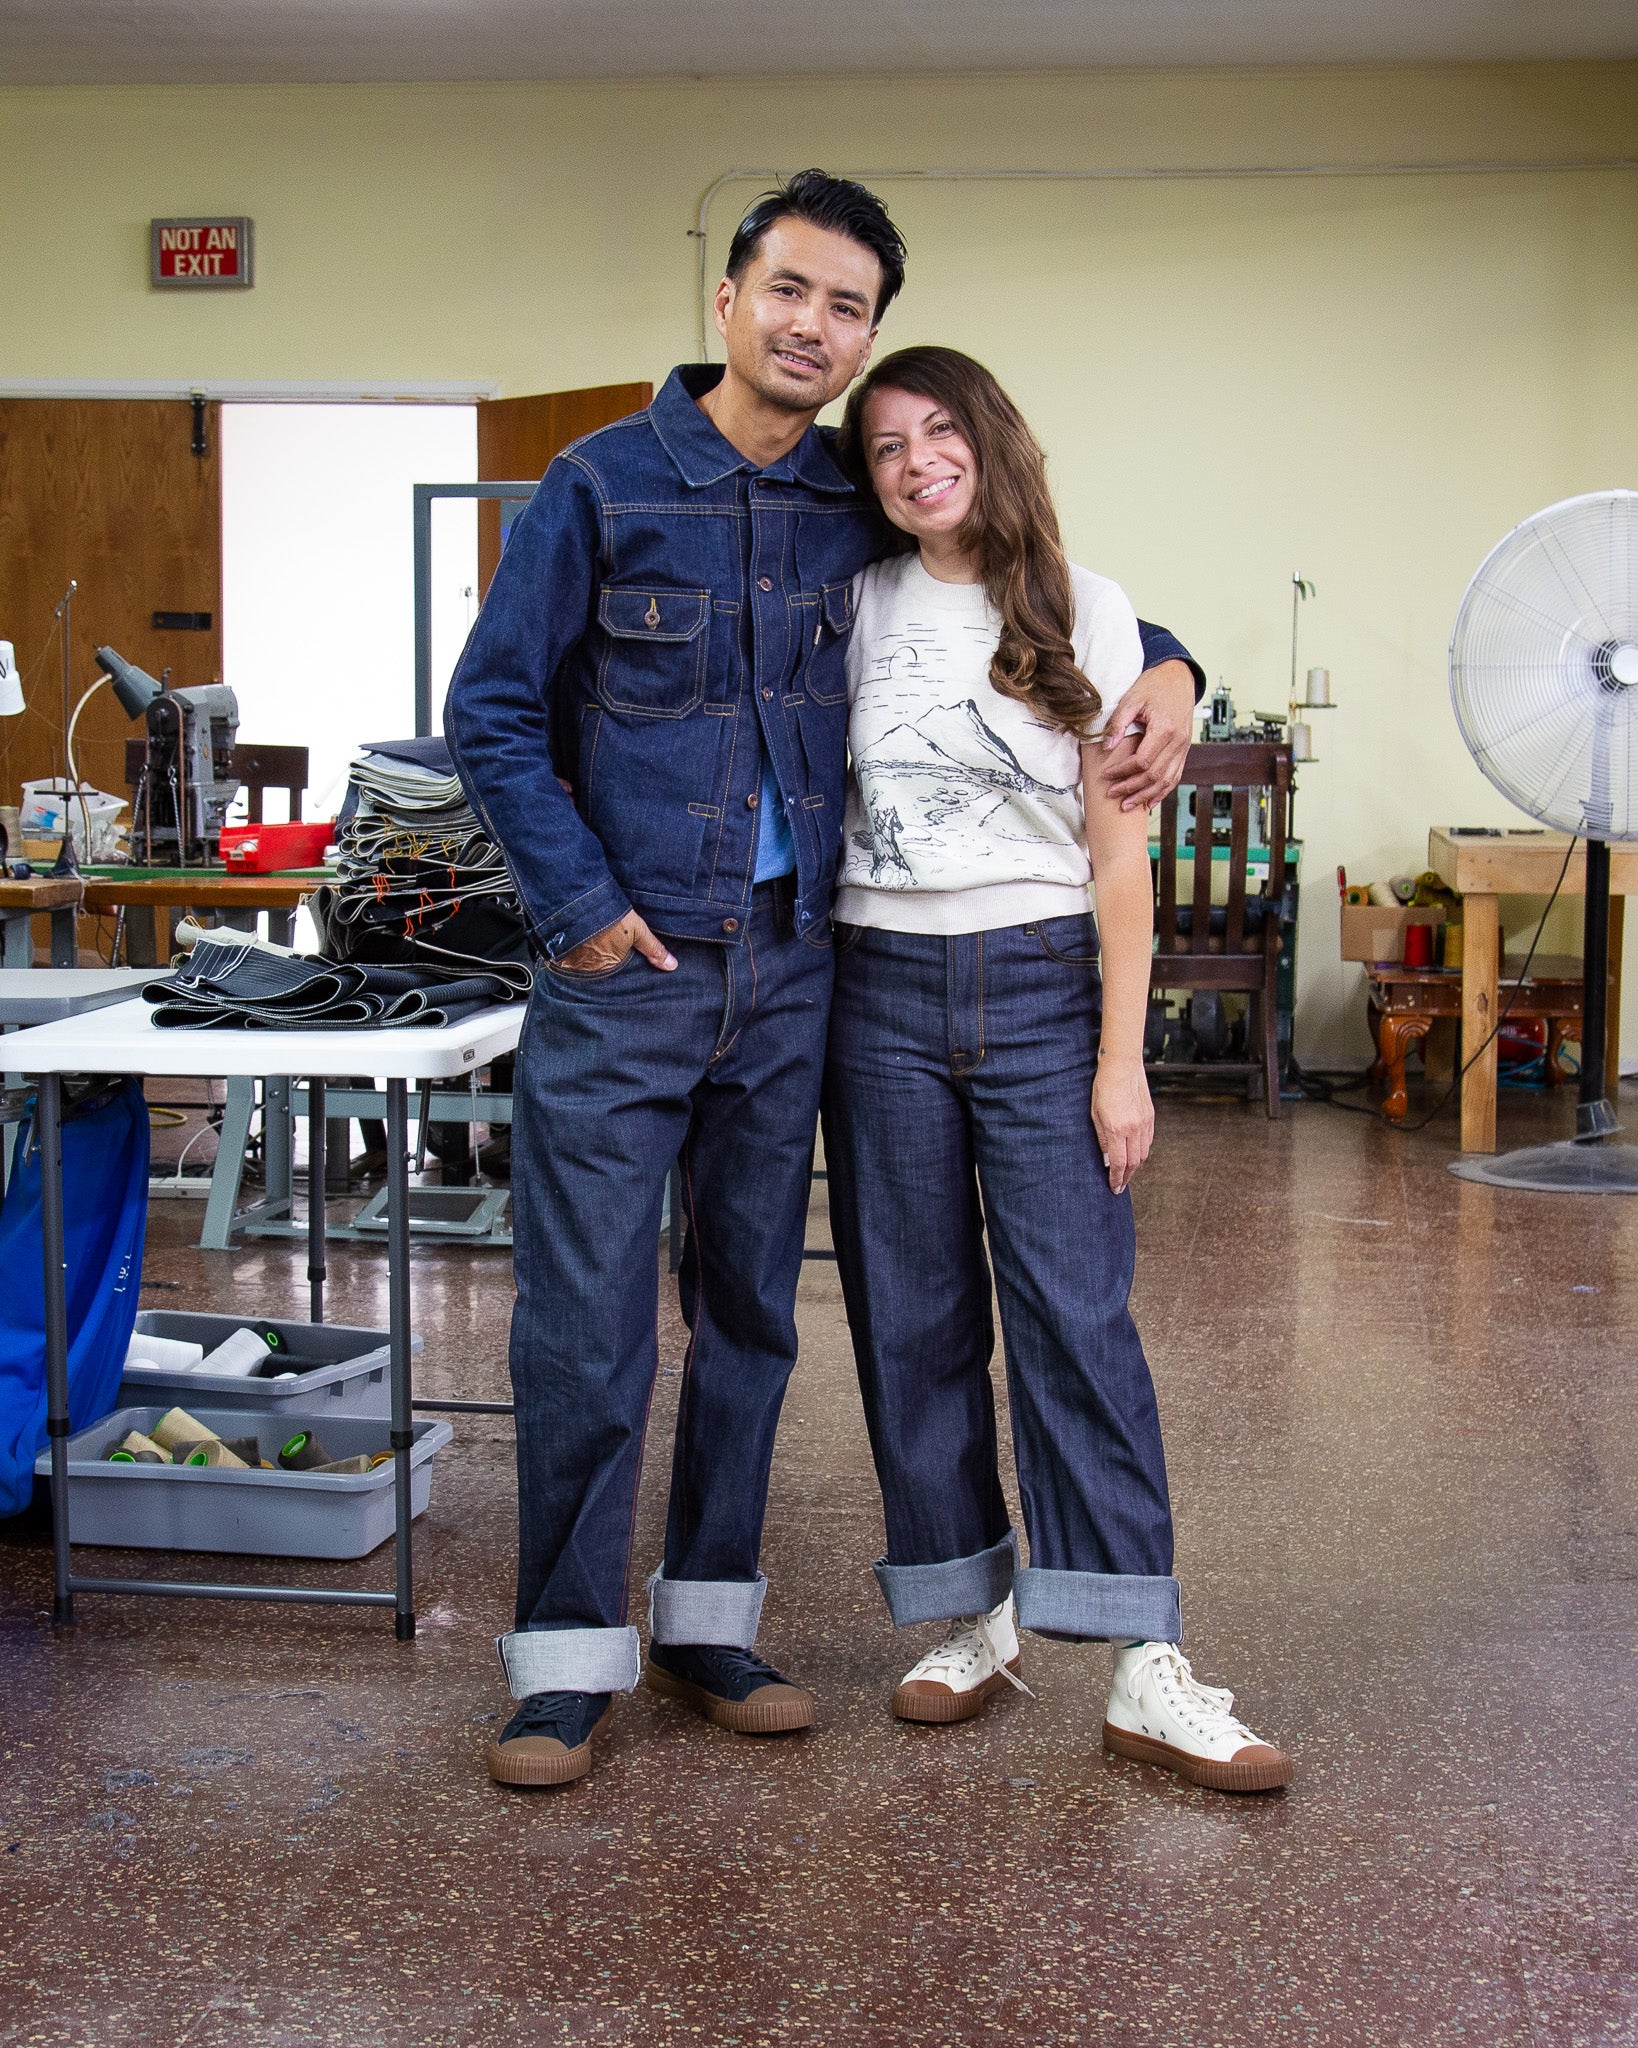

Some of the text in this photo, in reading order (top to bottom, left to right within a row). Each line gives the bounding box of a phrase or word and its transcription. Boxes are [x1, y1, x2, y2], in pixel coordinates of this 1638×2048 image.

[161, 227, 236, 251] NOT AN
[174, 253, 224, 276] EXIT
